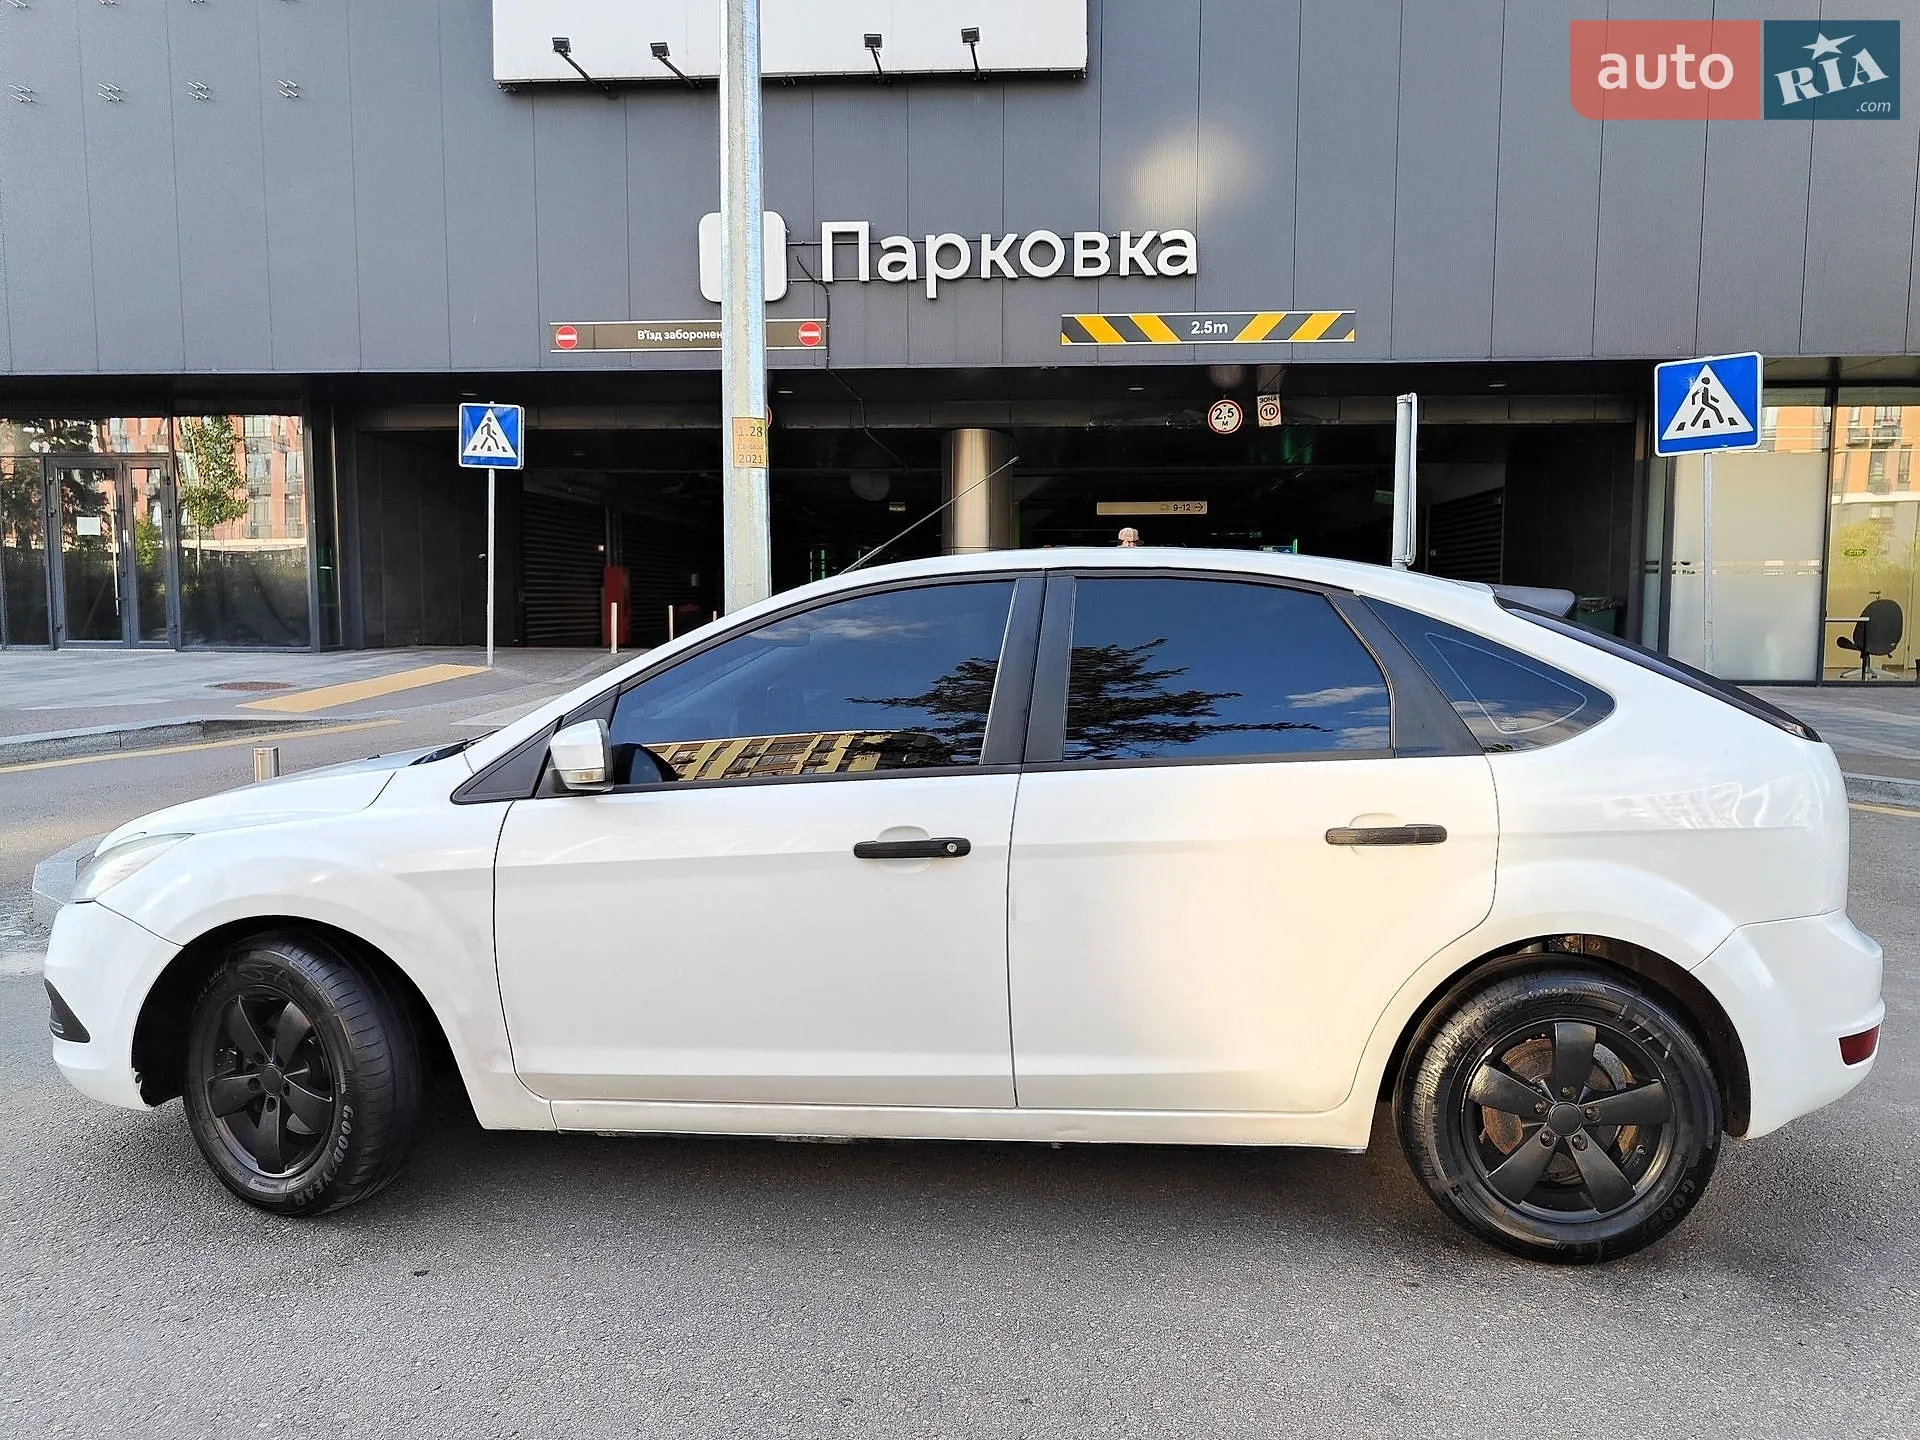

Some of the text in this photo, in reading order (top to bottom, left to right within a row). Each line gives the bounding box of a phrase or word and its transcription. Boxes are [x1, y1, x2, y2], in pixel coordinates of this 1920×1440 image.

[821, 220, 1198, 300] Парковка
[1190, 320, 1229, 335] 2.5m
[663, 328, 724, 342] заборонен
[1259, 396, 1278, 404] ЗОНА
[1214, 407, 1235, 421] 2,5
[1263, 407, 1276, 417] 10
[738, 454, 763, 464] 2021
[1173, 503, 1191, 512] 9-12
